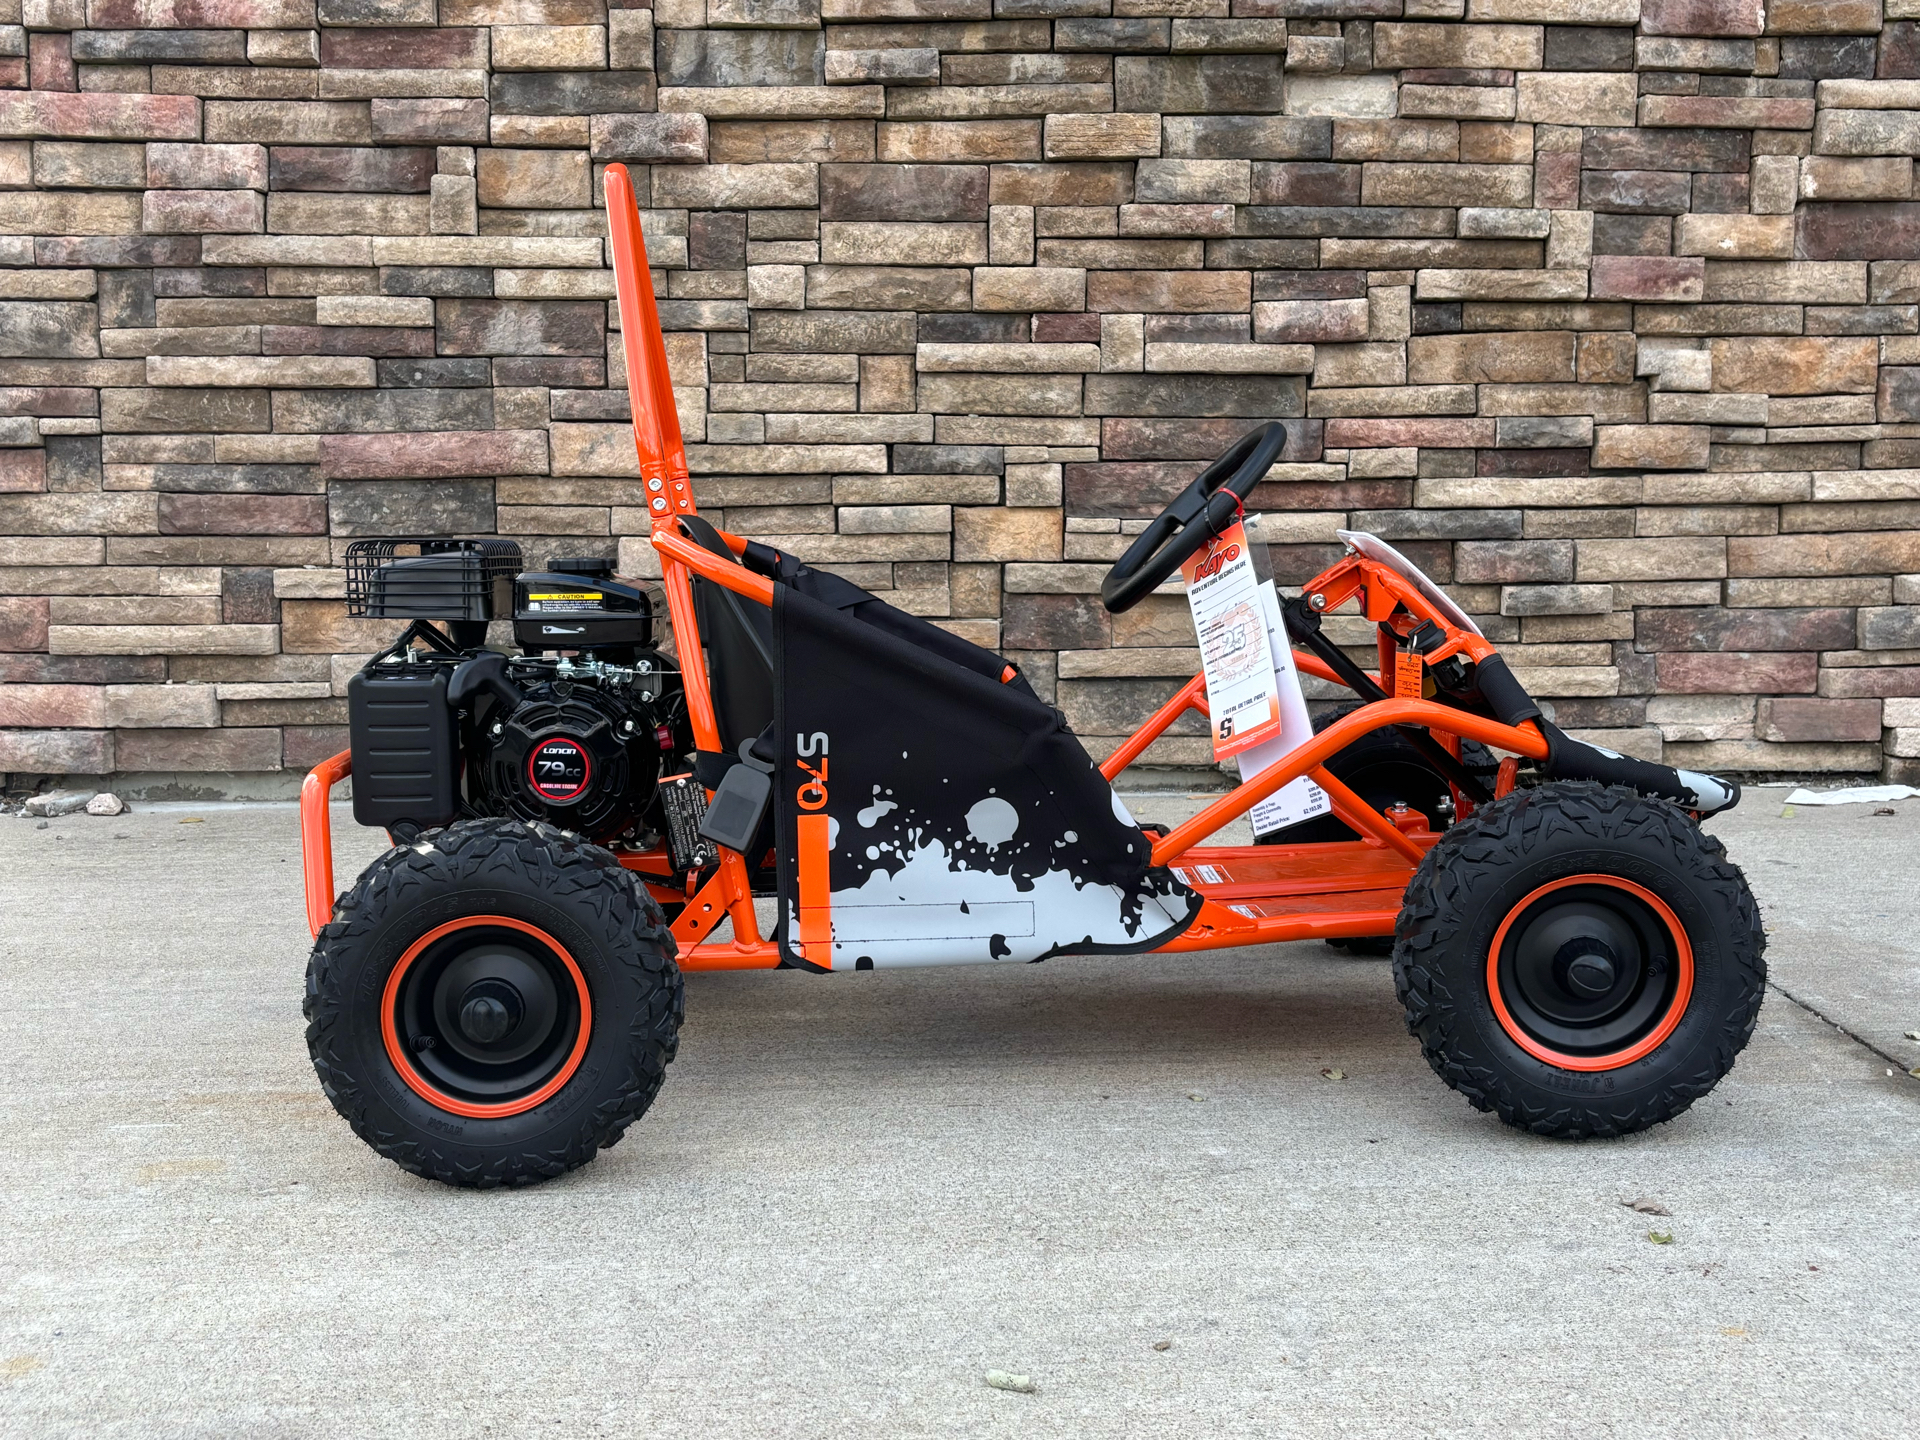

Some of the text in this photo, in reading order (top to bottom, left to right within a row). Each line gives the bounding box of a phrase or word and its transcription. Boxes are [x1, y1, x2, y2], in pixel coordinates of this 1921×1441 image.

[1192, 560, 1246, 595] ADVENTURE BEGINS HERE
[1194, 542, 1241, 584] KAYO
[1223, 691, 1266, 715] TOTAL RETAIL PRICE
[1220, 717, 1232, 740] $
[796, 732, 829, 811] S70
